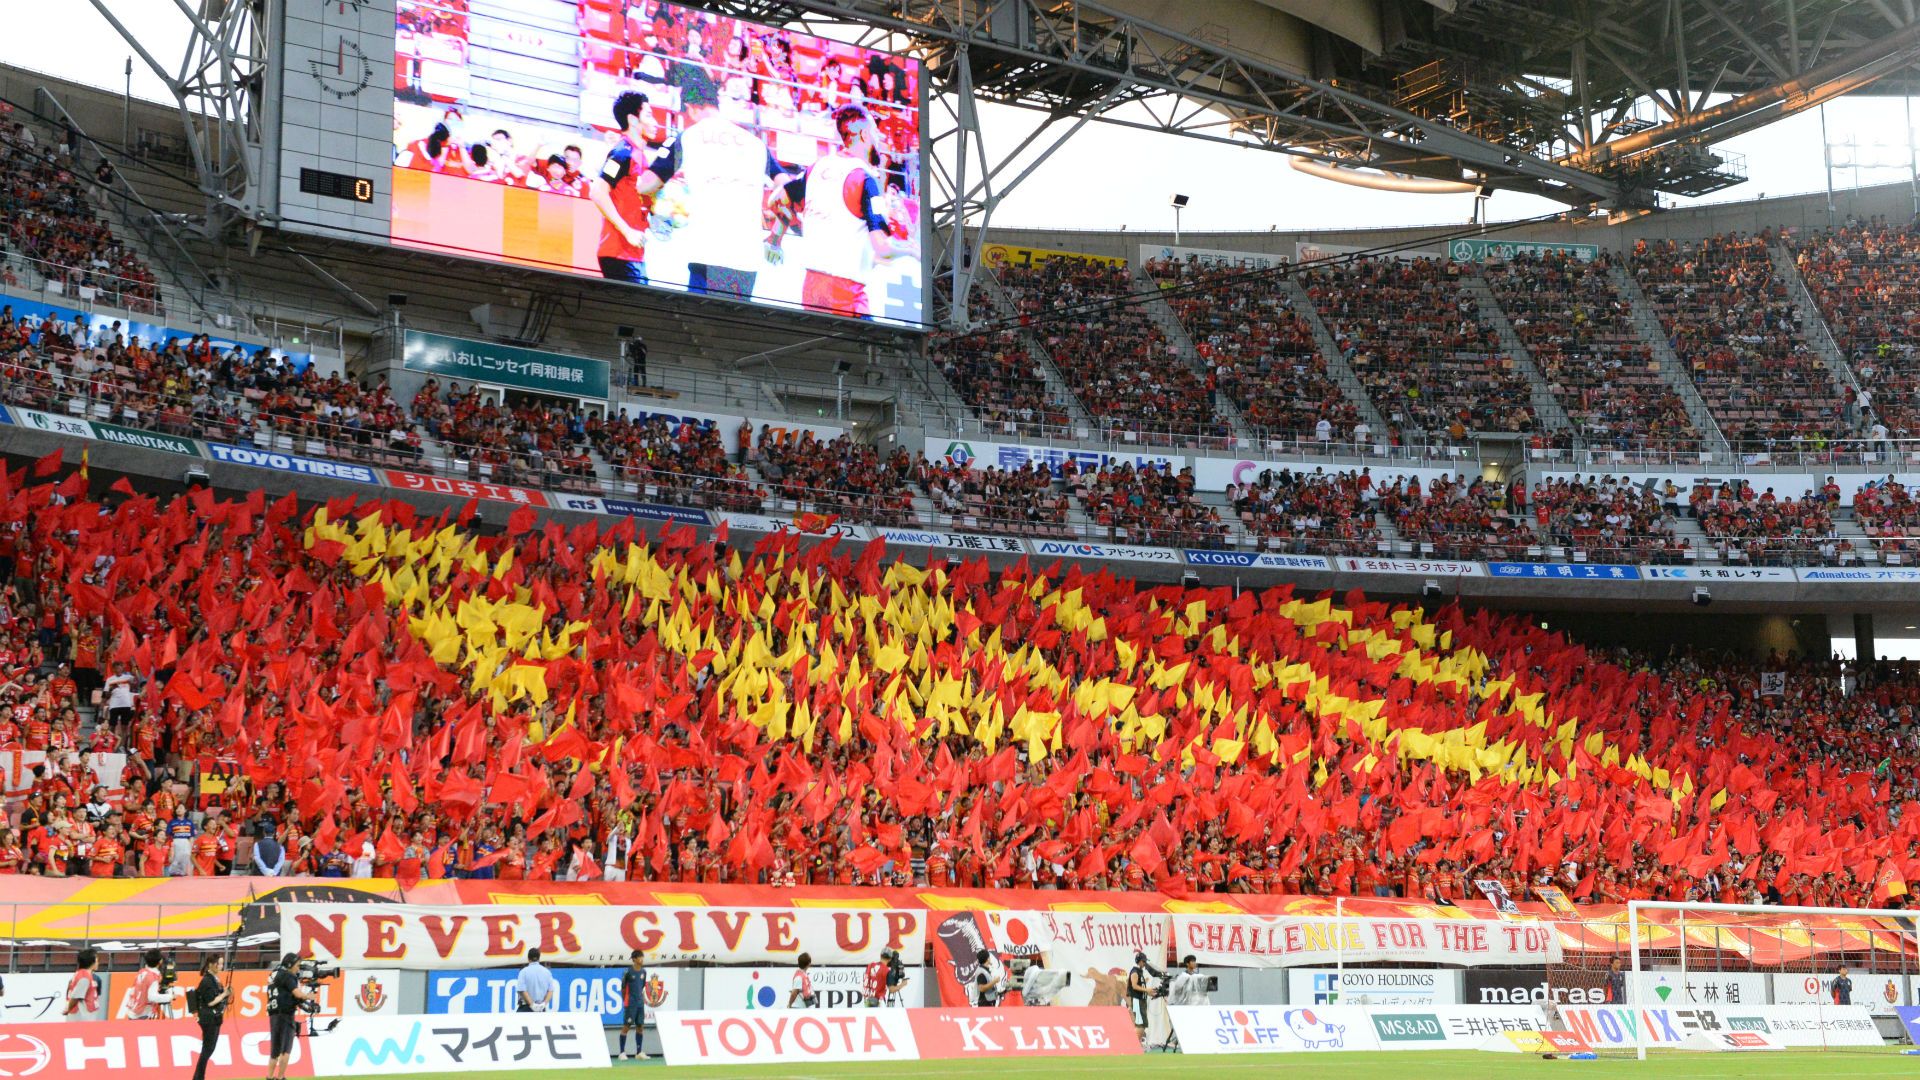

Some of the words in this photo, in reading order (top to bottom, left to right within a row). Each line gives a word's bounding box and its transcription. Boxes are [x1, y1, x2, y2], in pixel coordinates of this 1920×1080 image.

[355, 179, 371, 201] 0
[55, 420, 87, 435] 丸高
[101, 428, 190, 454] MARUTAKA
[212, 445, 290, 471] TOYO
[291, 457, 372, 483] TIRES
[404, 474, 531, 504] シロキ工業
[607, 504, 629, 513] FUEL
[631, 507, 657, 516] TOTAL
[658, 509, 704, 521] SYSTEMS
[884, 531, 941, 544] MANNOH
[946, 533, 1023, 552] 万能工業
[1040, 542, 1105, 556] ADVICS
[1188, 552, 1250, 566] KYOHO
[1364, 560, 1473, 573] 名鉄トヨタホテル
[1532, 565, 1625, 578] 新明工業
[1700, 568, 1781, 578] 共和レザー
[1804, 570, 1872, 580] Admatechs
[1876, 570, 1920, 580] アドマテ
[294, 911, 582, 960] NEVER
[620, 910, 799, 952] GIVE
[831, 911, 917, 952] UP
[1187, 921, 1367, 954] CHALLENGE
[1371, 922, 1428, 950] FOR
[1433, 923, 1490, 953] THE
[1501, 925, 1551, 954] TOP
[661, 953, 717, 961] NAGOYA
[1342, 973, 1375, 986] GOYO
[1378, 974, 1435, 986] HOLDINGS
[487, 979, 561, 1014] TOO
[569, 978, 623, 1015] GAS
[1480, 982, 1607, 1004] madras
[1683, 982, 1741, 1004] 大林組
[1217, 1009, 1261, 1027] HOT
[1565, 1007, 1682, 1043] MOVIX
[1729, 1020, 1767, 1031] MS&AD
[681, 1016, 897, 1057] TOYOTA
[1378, 1019, 1439, 1036] MS&AD
[431, 1024, 582, 1063] マイナビ
[1010, 1025, 1111, 1051] LINE
[64, 1030, 302, 1070] HINO
